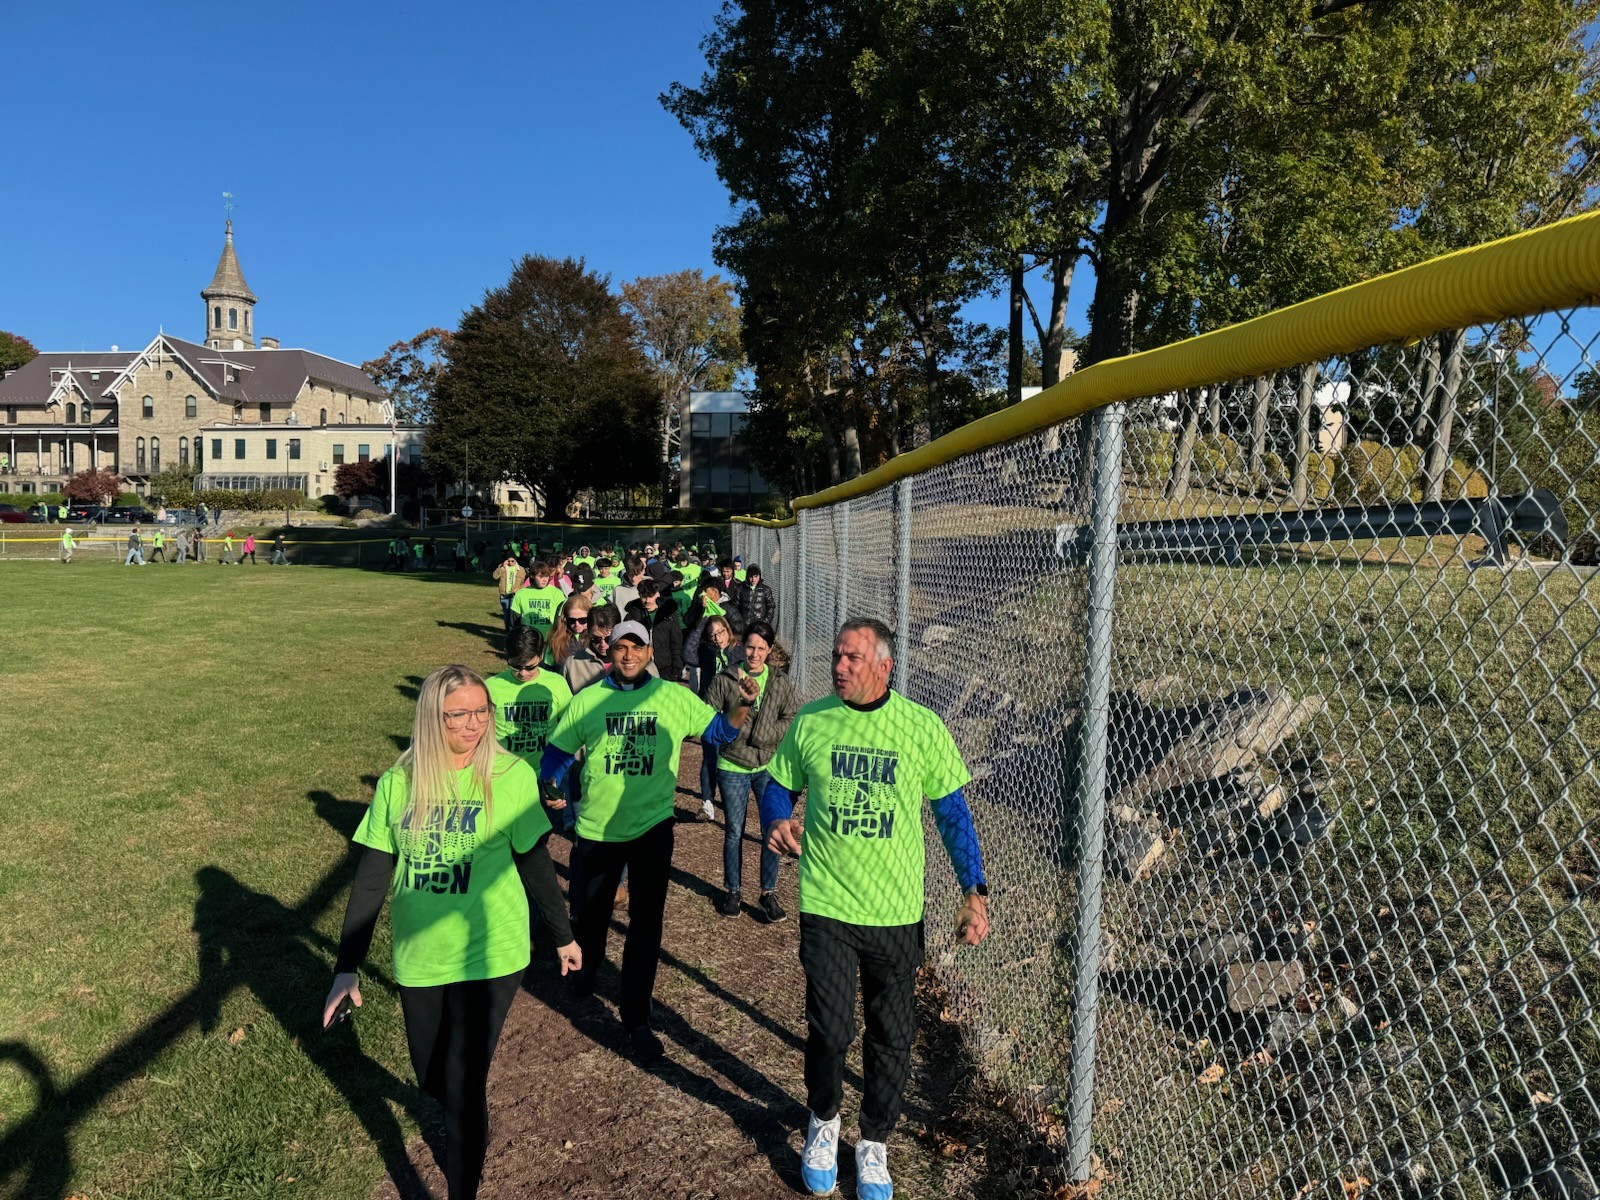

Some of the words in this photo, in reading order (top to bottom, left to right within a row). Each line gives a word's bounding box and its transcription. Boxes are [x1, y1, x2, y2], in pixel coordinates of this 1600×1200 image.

[529, 600, 551, 609] WALK
[504, 706, 549, 722] WALK
[605, 716, 658, 736] WALK
[505, 734, 546, 753] THON
[831, 744, 860, 753] SALESIAN
[860, 746, 876, 755] HIGH
[876, 749, 899, 758] SCHOOL
[604, 754, 655, 776] THON
[831, 751, 899, 785] WALK
[853, 782, 871, 810] A
[828, 806, 895, 839] THON
